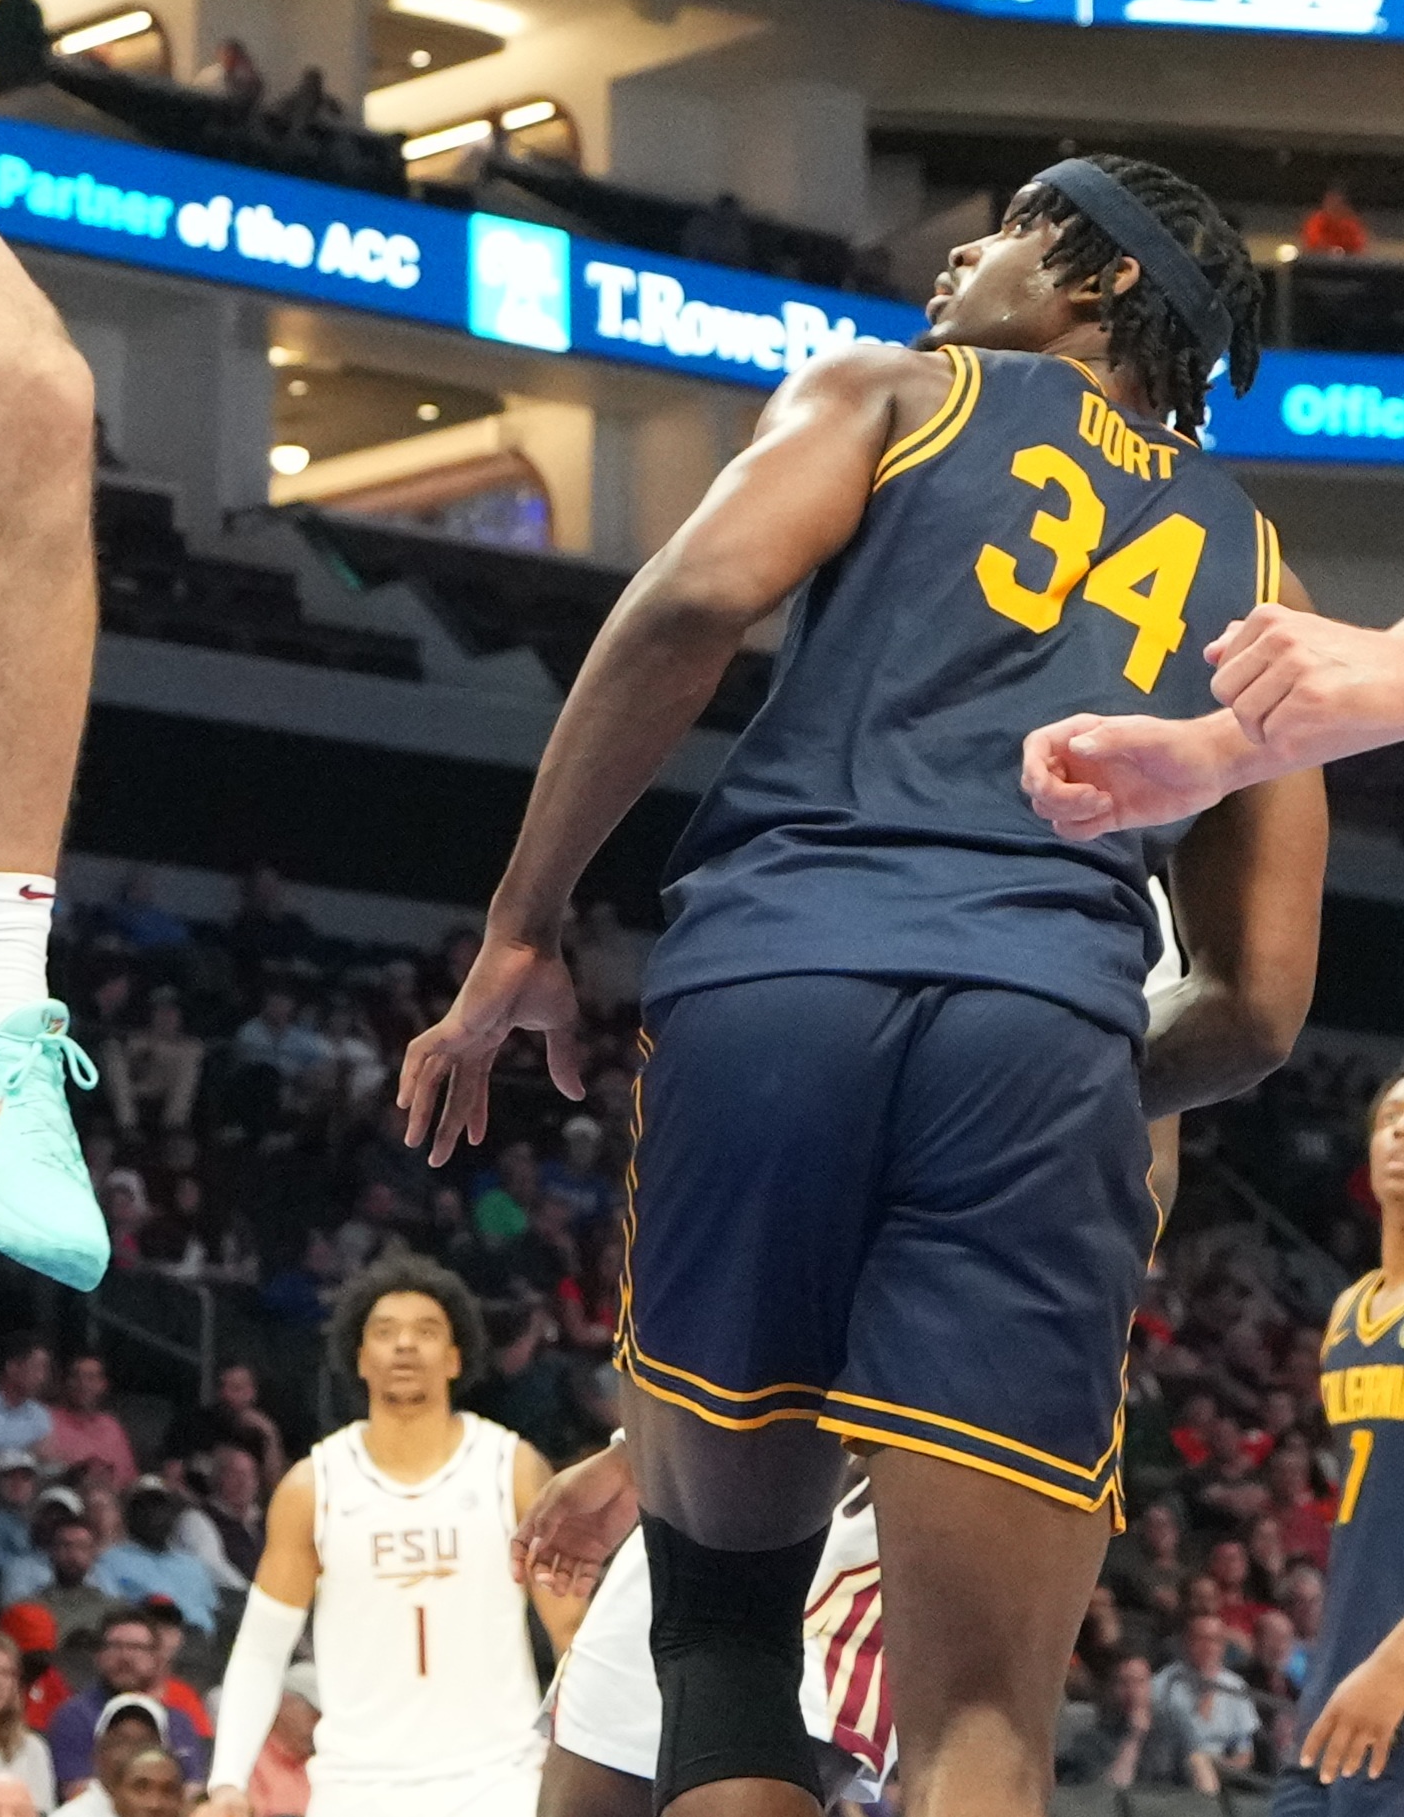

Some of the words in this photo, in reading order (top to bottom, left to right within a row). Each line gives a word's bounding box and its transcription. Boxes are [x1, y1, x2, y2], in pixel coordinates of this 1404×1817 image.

[176, 195, 234, 252] of
[234, 204, 316, 269] the
[316, 221, 422, 290] ACC
[1079, 390, 1180, 482] DORT
[974, 443, 1207, 695] 34
[1338, 1428, 1375, 1525] 1
[371, 1527, 460, 1567] FSU
[415, 1604, 428, 1678] 1
